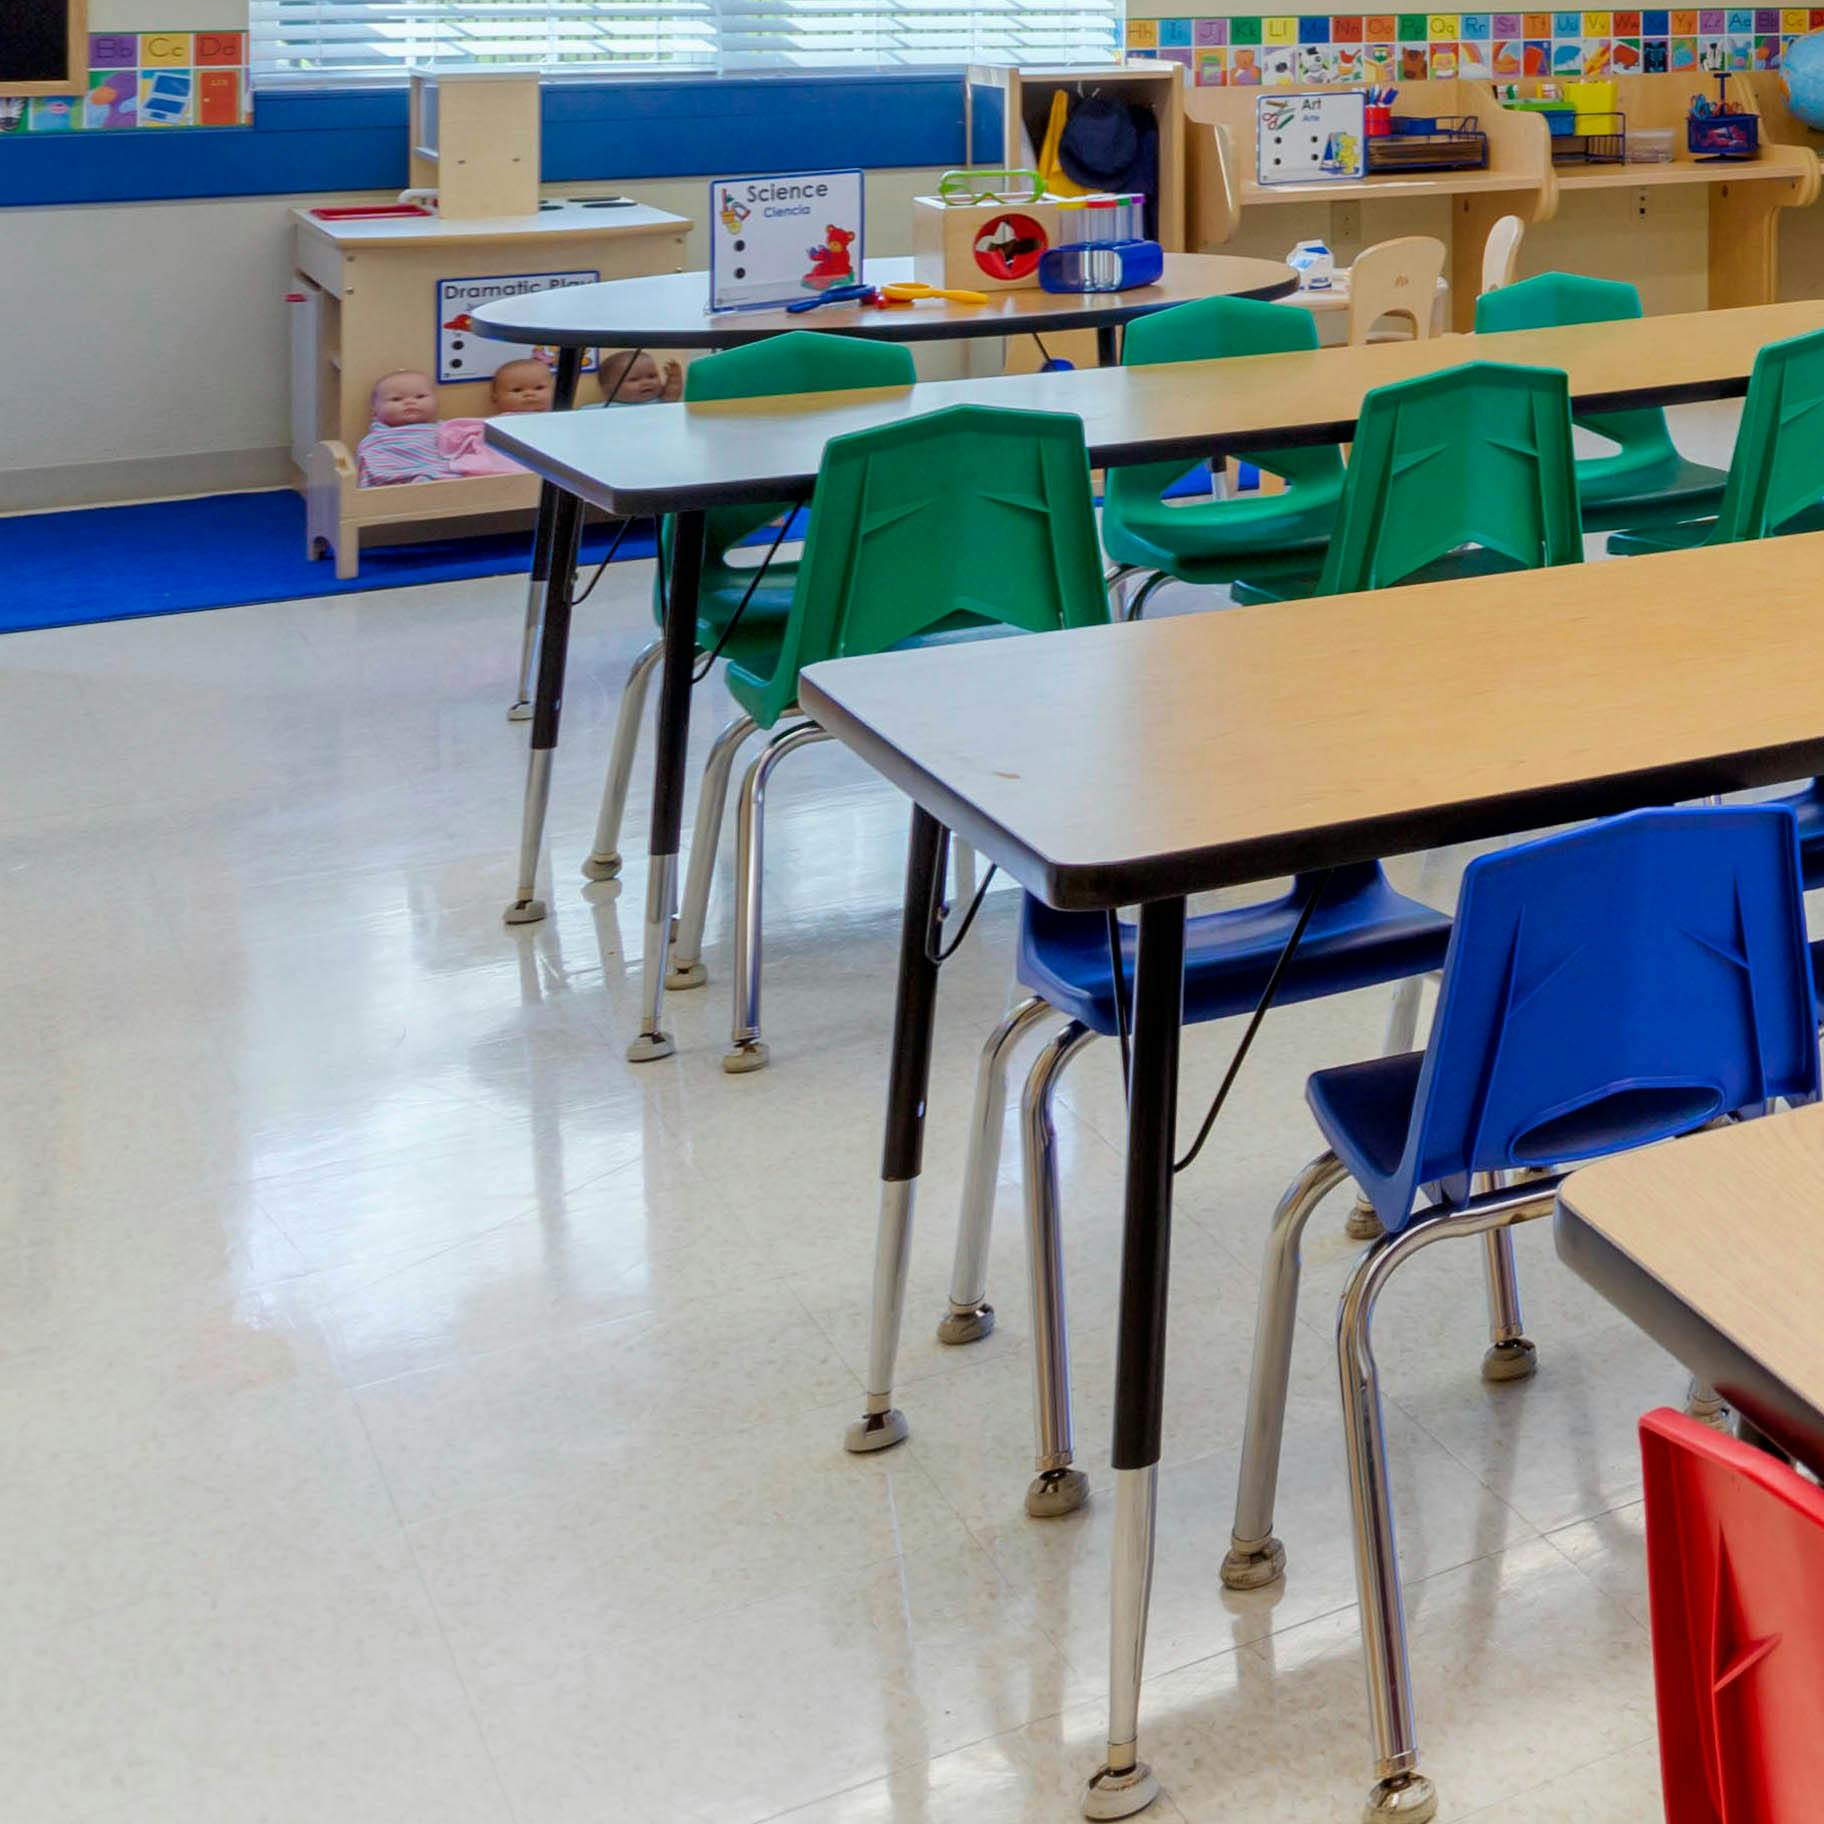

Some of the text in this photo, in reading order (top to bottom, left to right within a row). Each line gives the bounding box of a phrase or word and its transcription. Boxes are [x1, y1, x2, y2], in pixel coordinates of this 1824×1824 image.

[147, 36, 185, 58] Cc
[1301, 99, 1322, 111] Art
[746, 181, 829, 203] Science
[762, 204, 812, 219] Ciencia
[443, 279, 541, 301] Dramatic
